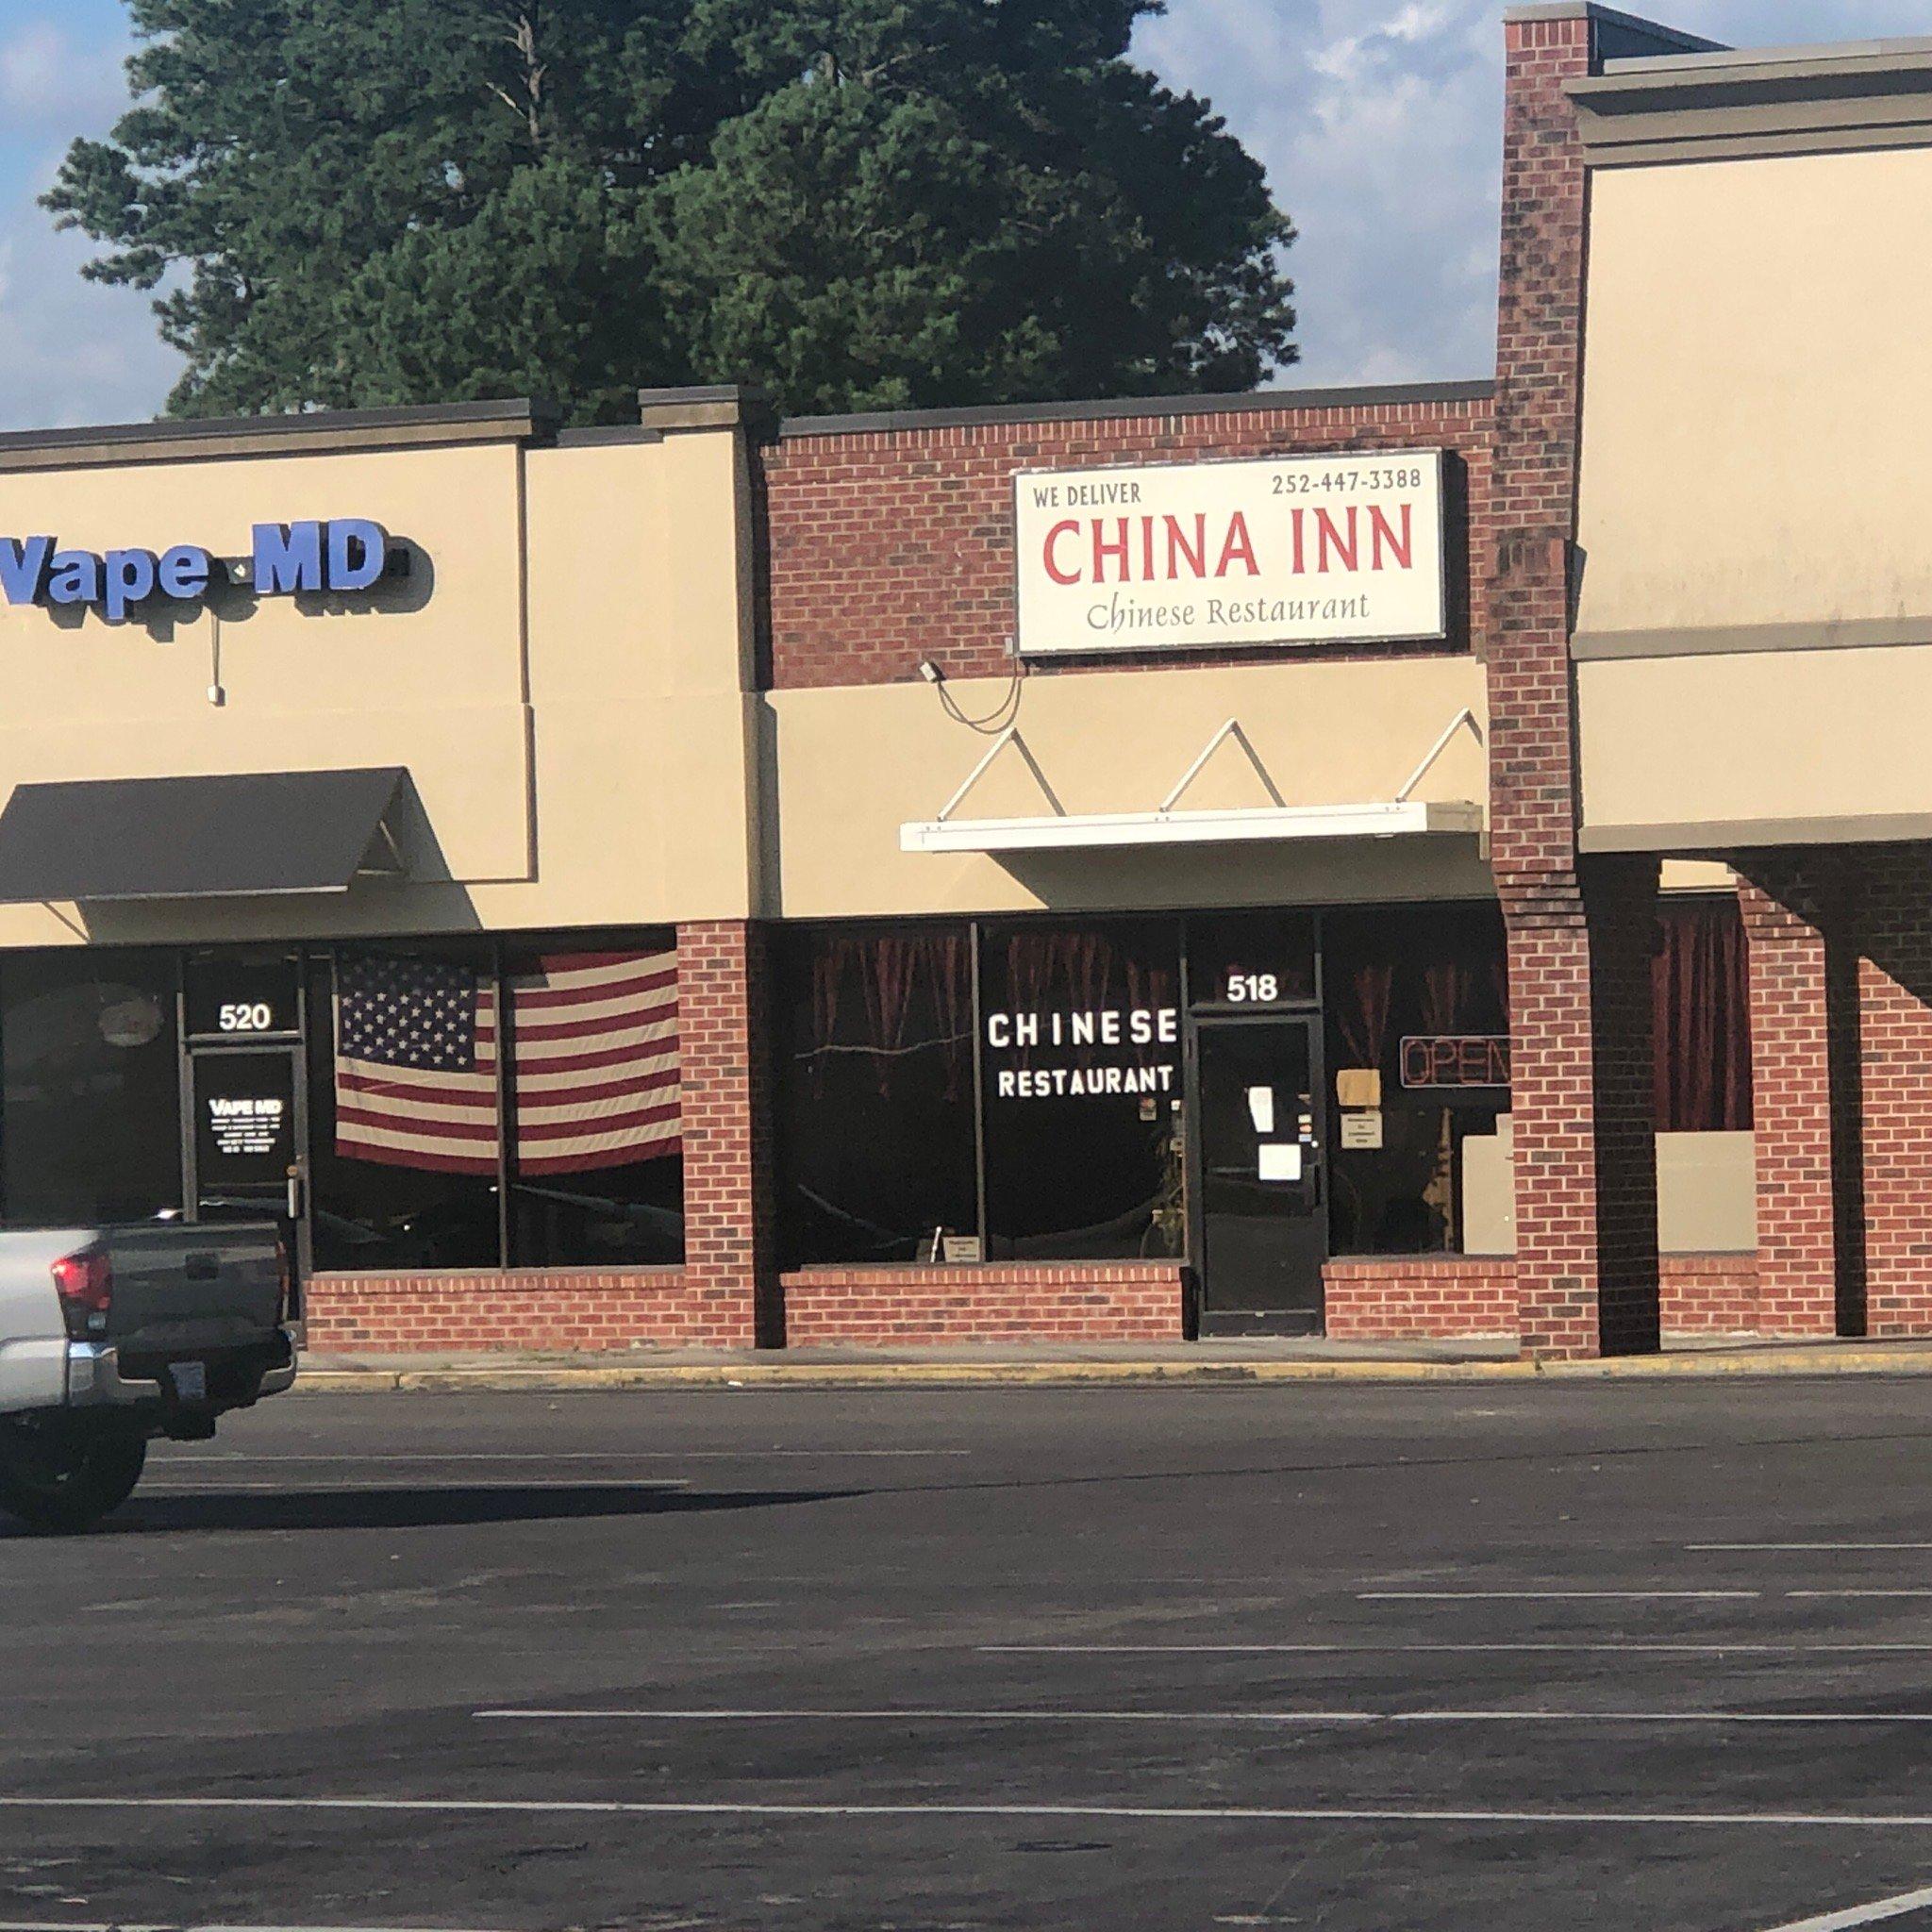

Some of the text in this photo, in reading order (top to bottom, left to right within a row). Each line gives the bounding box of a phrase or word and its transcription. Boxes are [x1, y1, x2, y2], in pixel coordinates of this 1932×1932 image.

[1033, 482, 1141, 508] WE DELIVER
[1272, 468, 1422, 495] 252-447-3388
[1042, 503, 1412, 586] CHINA INN
[0, 519, 385, 620] Vape MD
[1087, 591, 1371, 634] Chinese Restaurant
[1227, 974, 1278, 1002] 518
[219, 1003, 271, 1030] 520
[988, 1008, 1177, 1048] CHINESE
[998, 1065, 1174, 1097] RESTAURANT
